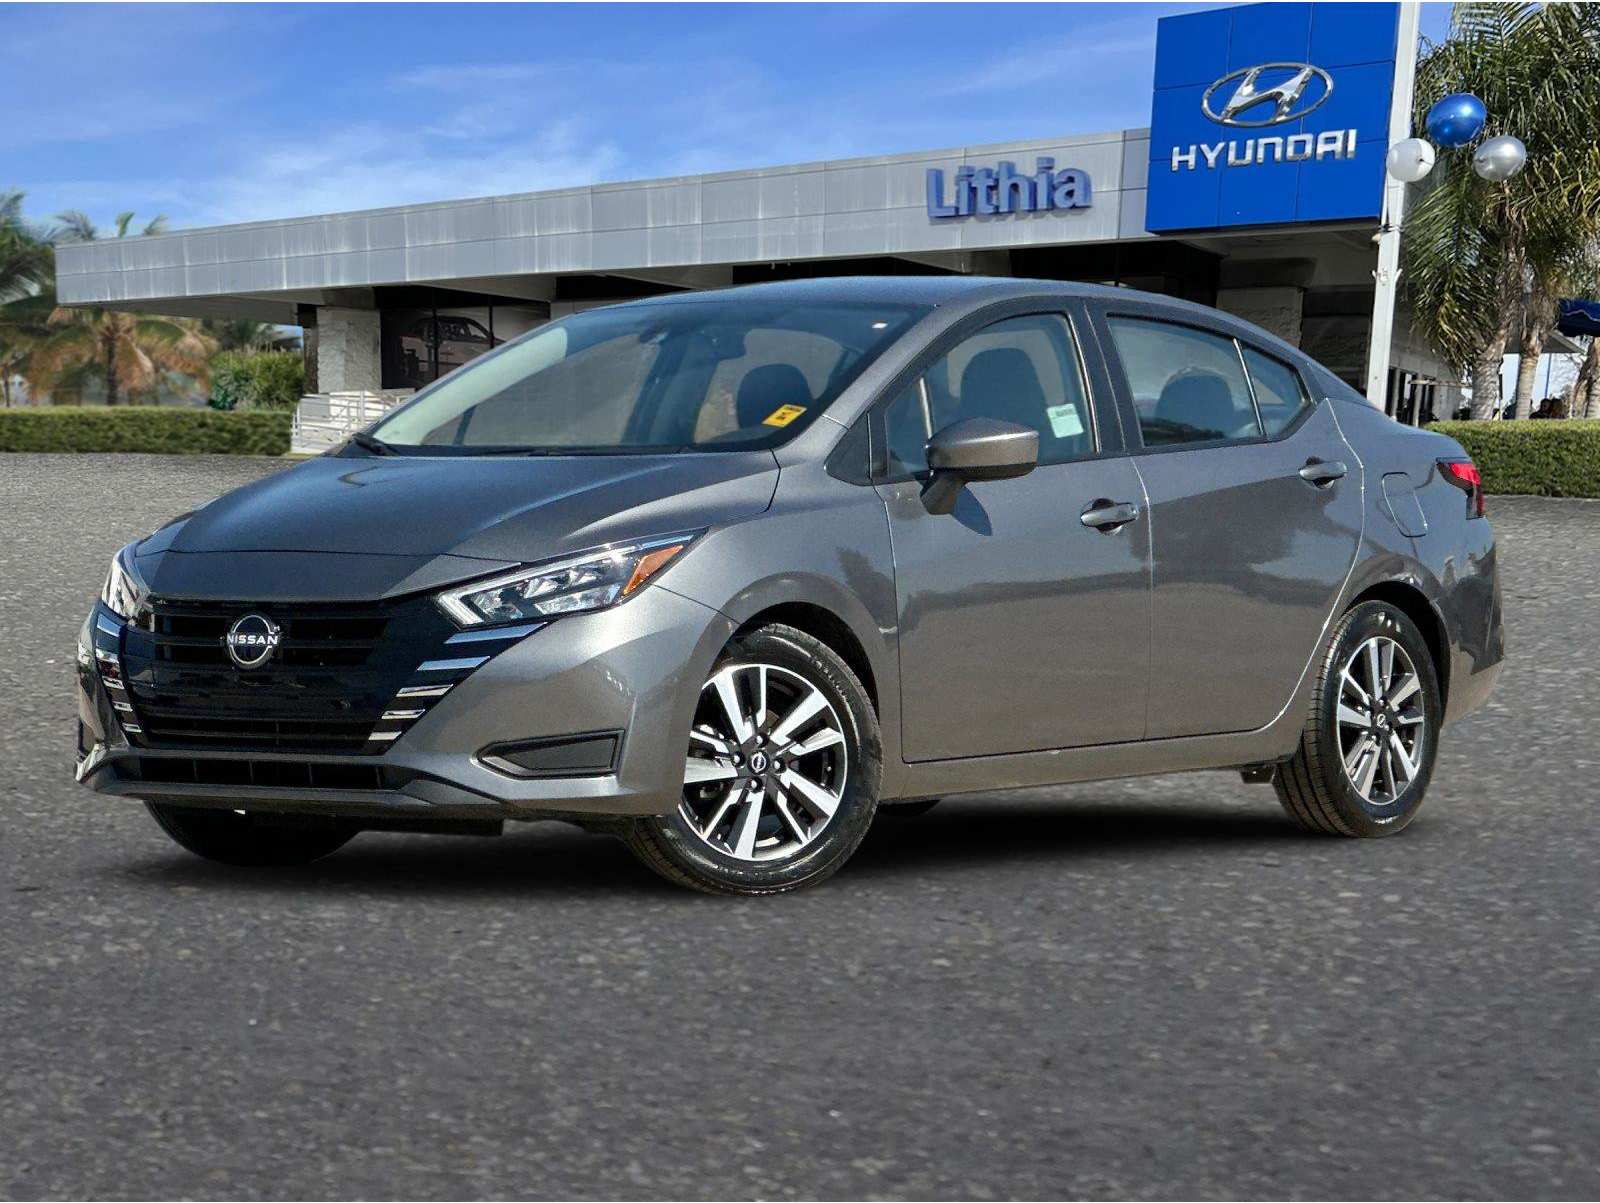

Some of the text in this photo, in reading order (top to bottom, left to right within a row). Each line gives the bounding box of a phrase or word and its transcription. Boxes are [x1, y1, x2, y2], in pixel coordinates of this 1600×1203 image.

[1171, 128, 1358, 172] HYUNDAI
[926, 156, 1093, 219] Lithia
[226, 633, 279, 646] NISSAN
